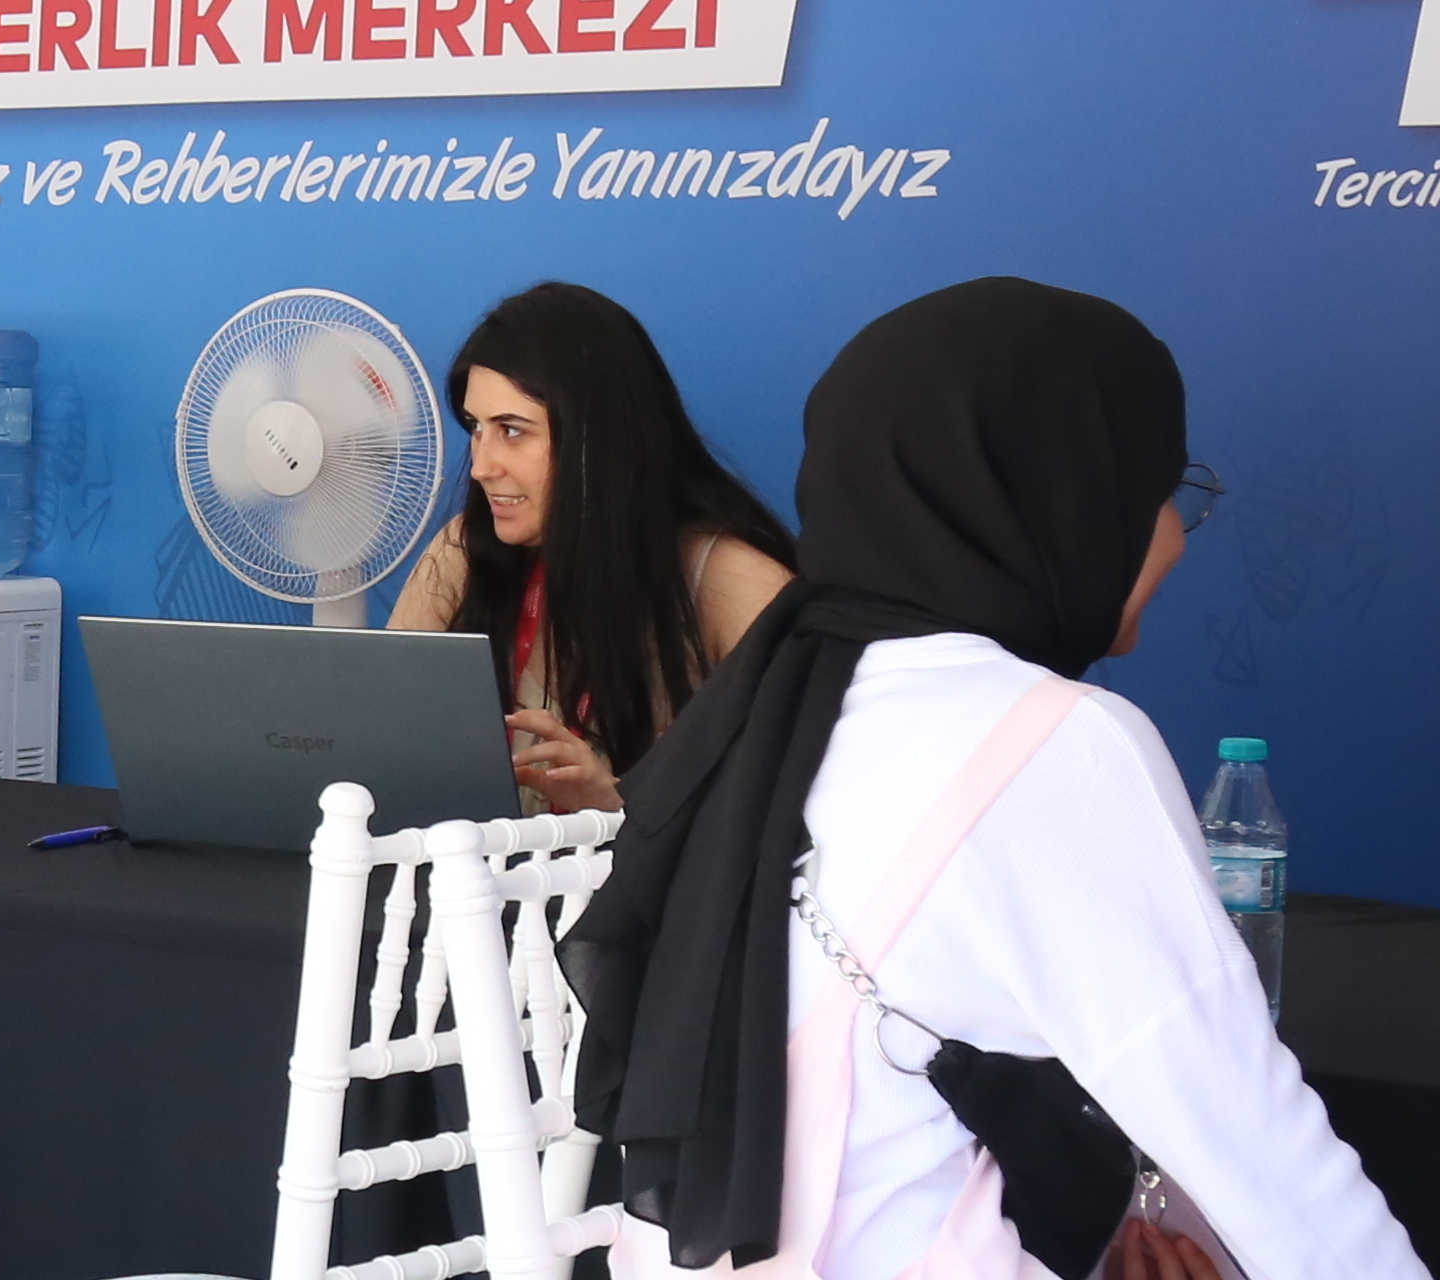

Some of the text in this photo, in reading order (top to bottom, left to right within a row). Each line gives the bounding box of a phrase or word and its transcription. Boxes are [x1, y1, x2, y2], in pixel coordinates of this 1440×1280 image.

[22, 156, 83, 206] ve
[94, 129, 537, 206] Rehberlerimizle
[551, 117, 951, 221] Yanınızdayız
[266, 732, 336, 754] Casper
